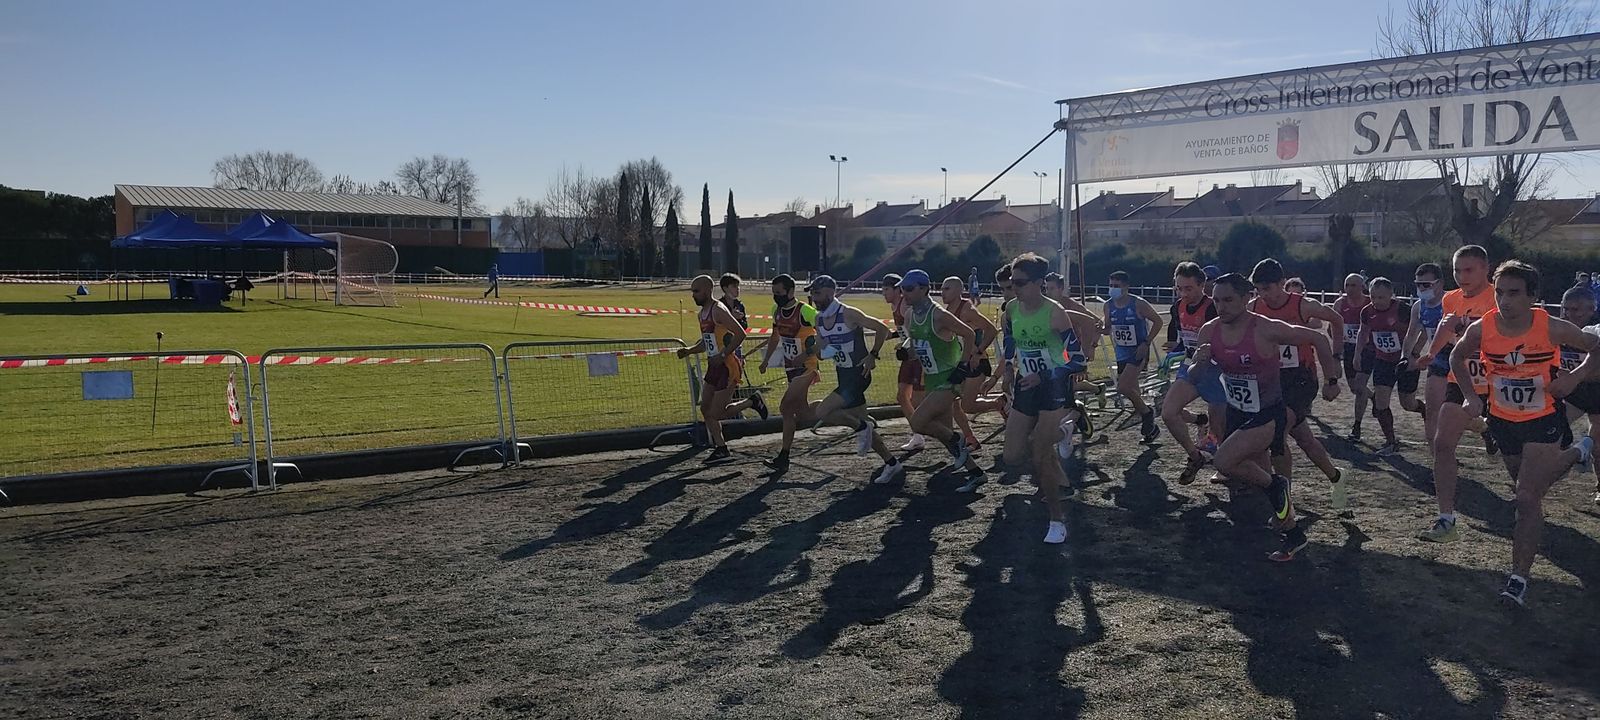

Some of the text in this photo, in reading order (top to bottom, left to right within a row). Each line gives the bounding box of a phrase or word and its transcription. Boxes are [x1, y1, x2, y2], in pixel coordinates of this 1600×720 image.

[1203, 93, 1270, 118] Cross
[1279, 63, 1460, 111] Internacional
[1470, 60, 1511, 92] de
[1352, 95, 1579, 155] SALIDA
[1185, 133, 1270, 149] AYUNTAMIENTO DE
[1193, 144, 1269, 159] VENTA DE BAÑOS
[1115, 330, 1133, 341] 962
[1347, 329, 1358, 339] 95
[1377, 337, 1396, 348] 955
[833, 350, 846, 363] 69
[919, 355, 933, 368] 68
[1022, 357, 1047, 373] 106
[1468, 359, 1486, 377] 08
[1226, 383, 1252, 404] 952
[1500, 385, 1536, 404] 107
